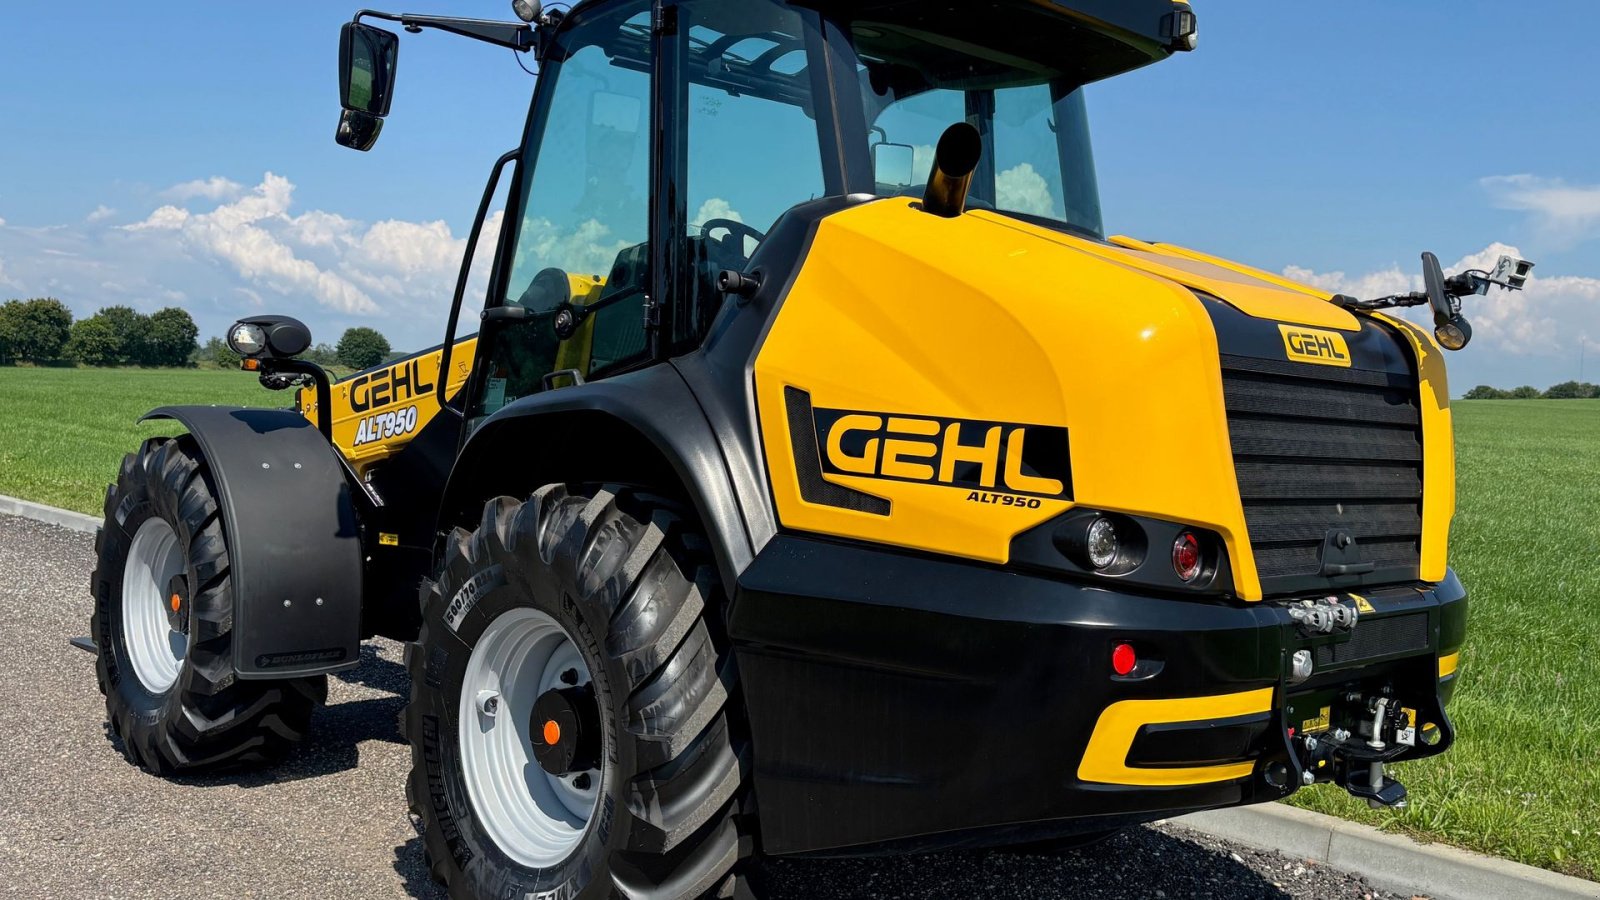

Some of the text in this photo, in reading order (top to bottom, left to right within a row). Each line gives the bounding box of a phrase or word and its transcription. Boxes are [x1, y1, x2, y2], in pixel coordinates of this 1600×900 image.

[1286, 331, 1345, 359] GEHL
[349, 359, 433, 413] GEHL
[353, 405, 418, 446] ALT950
[827, 414, 1063, 495] GEHL
[966, 491, 1042, 509] ALT950
[445, 583, 476, 623] 500/70
[423, 716, 458, 841] MICHELIN
